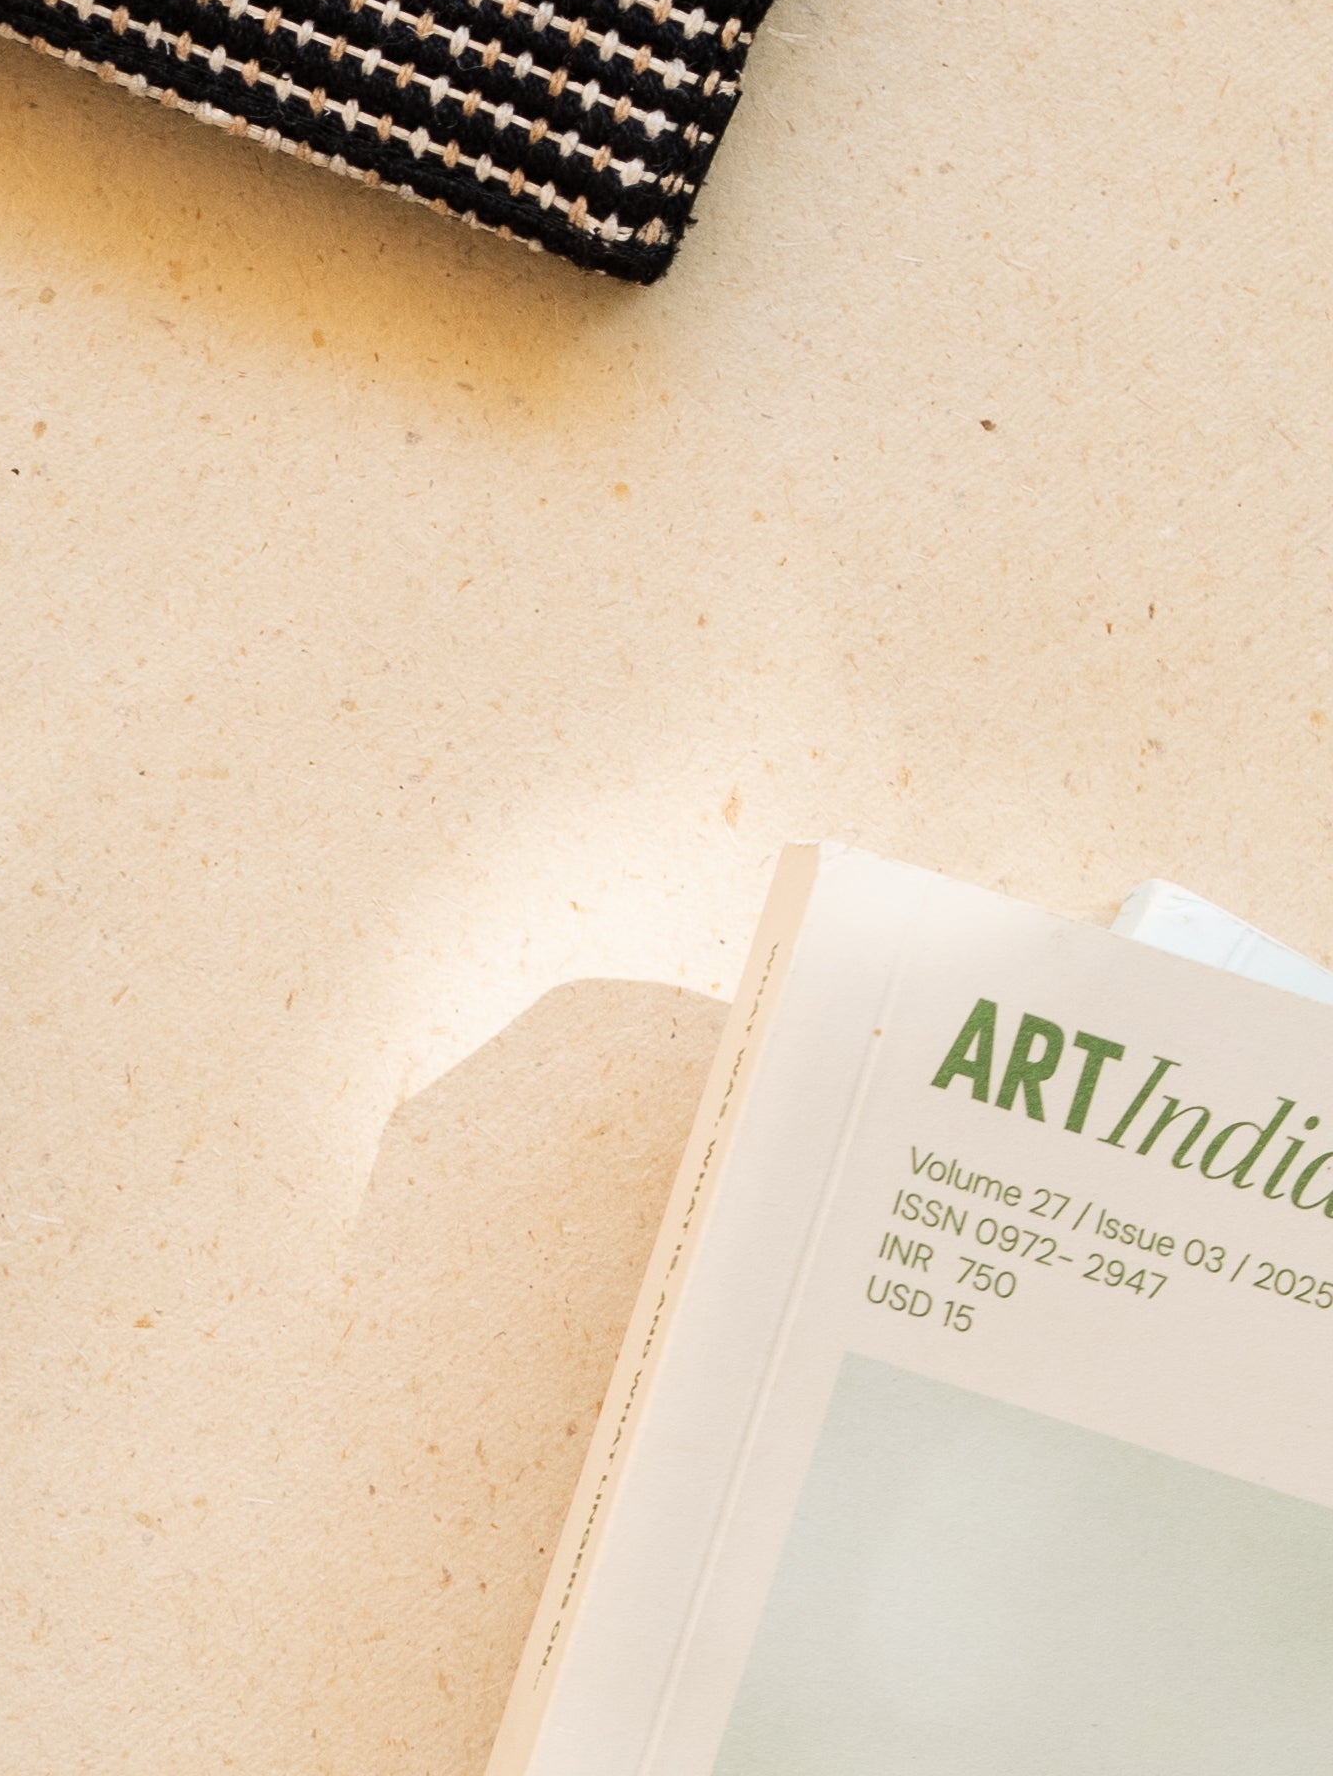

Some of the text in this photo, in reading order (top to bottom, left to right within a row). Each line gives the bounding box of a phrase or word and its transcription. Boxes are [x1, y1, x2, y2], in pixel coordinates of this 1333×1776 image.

[745, 942, 779, 1034] WHAT
[680, 1137, 717, 1231] WHAT
[909, 1145, 1333, 1309] Volume 27 / Issue 03 / 2025
[878, 1231, 1017, 1299] INR 750
[892, 1189, 967, 1238] ISSN
[1083, 1253, 1168, 1300] 2947
[641, 1290, 666, 1359] AND
[866, 1275, 975, 1333] USD 15
[608, 1369, 642, 1463] WHAT
[559, 1473, 608, 1610] LINGERS
